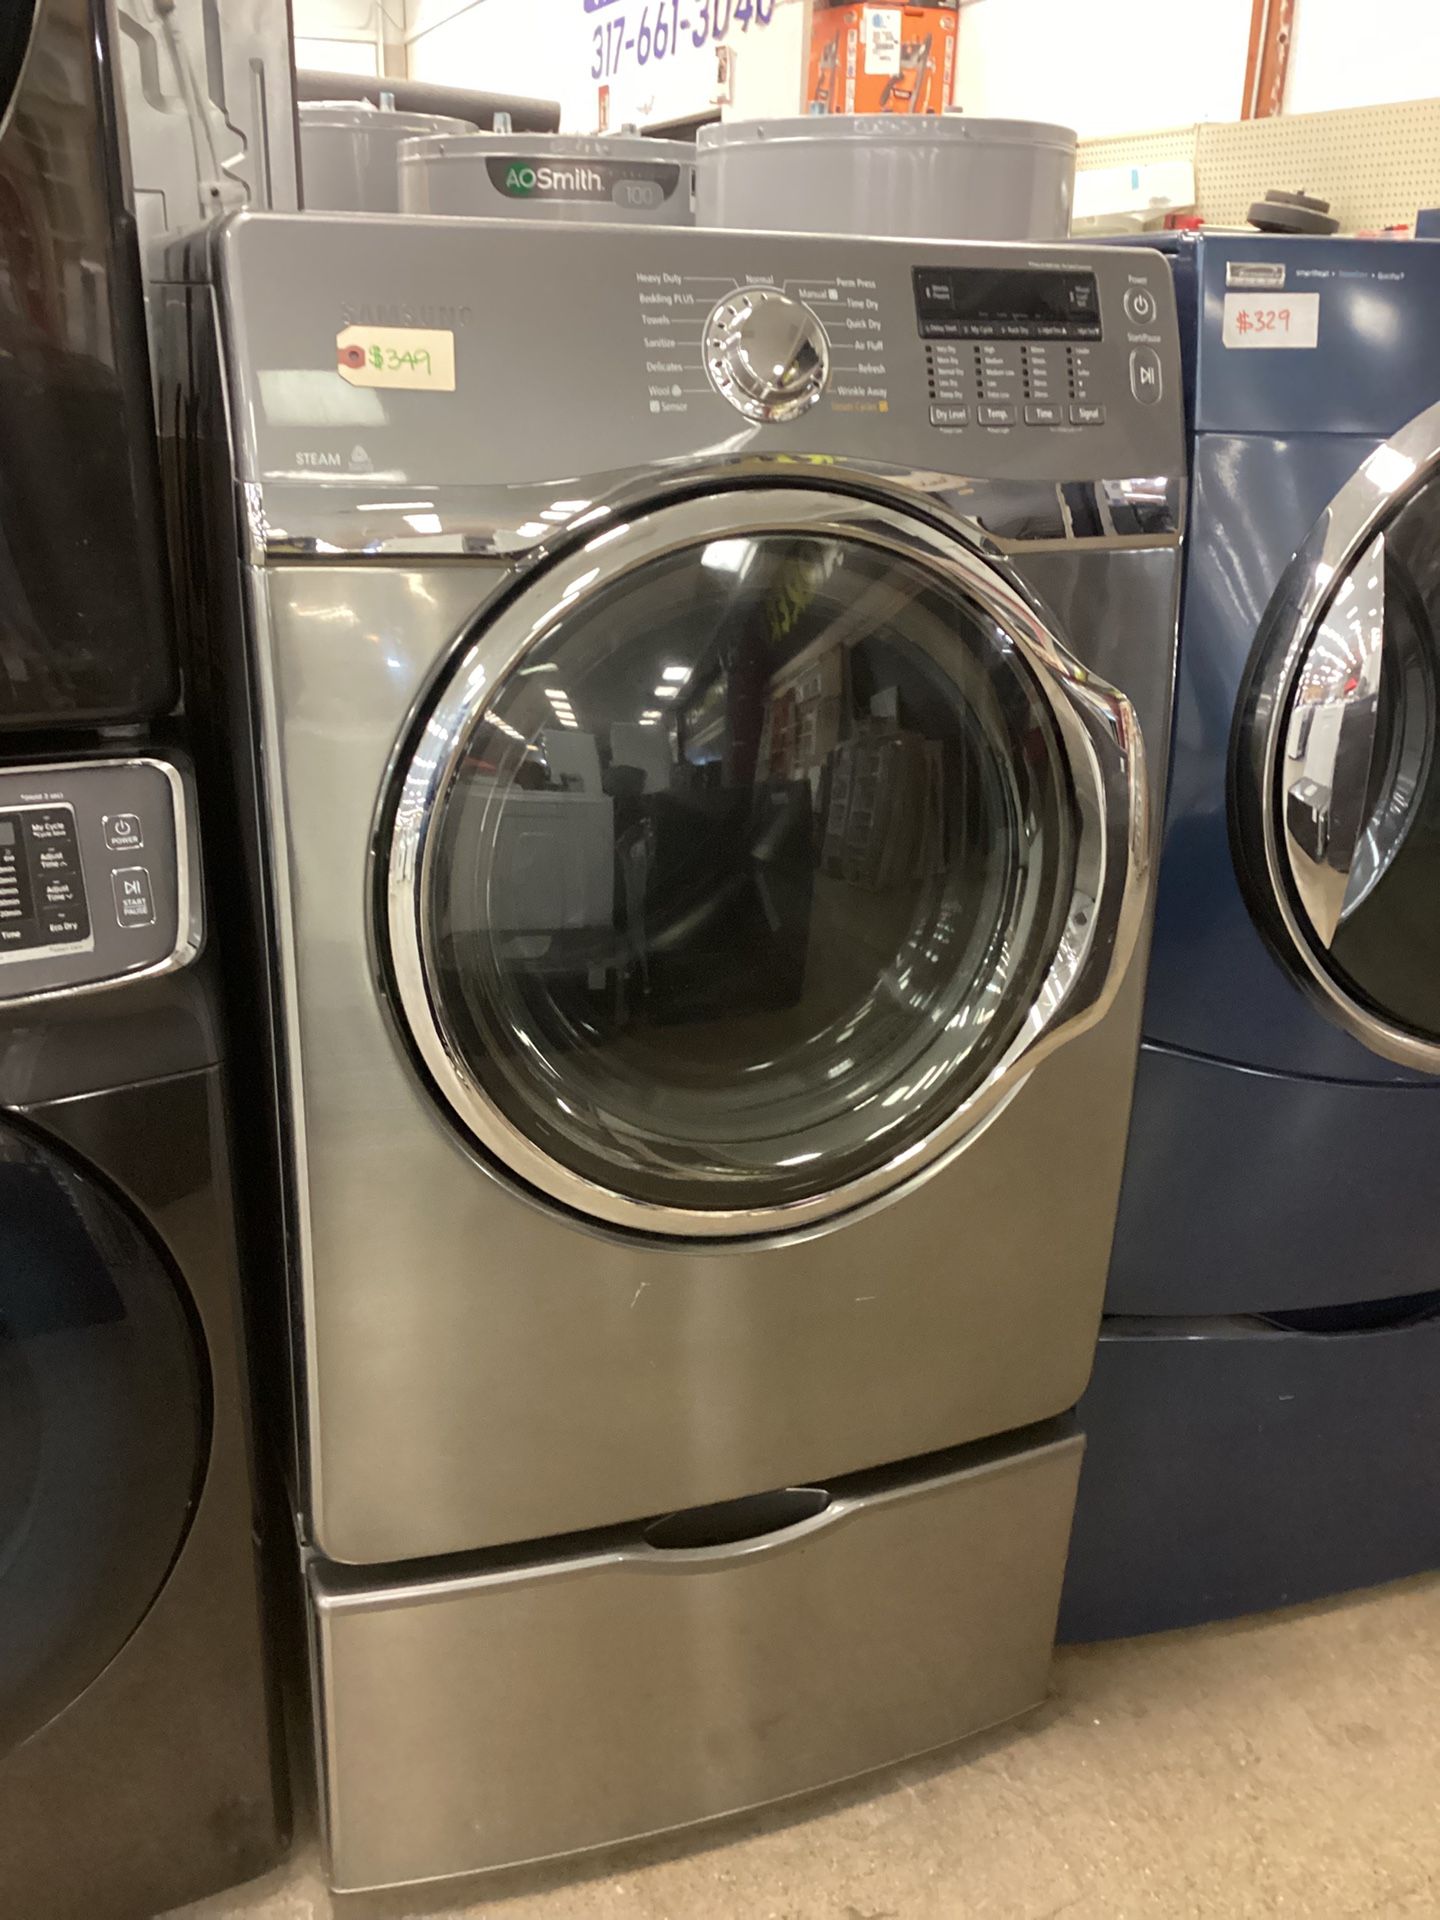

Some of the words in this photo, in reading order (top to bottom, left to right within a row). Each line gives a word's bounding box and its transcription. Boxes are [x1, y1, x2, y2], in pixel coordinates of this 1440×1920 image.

[625, 184, 653, 200] 100
[637, 273, 661, 285] Heavy
[663, 273, 682, 285] Duty
[746, 275, 774, 285] Normal
[836, 278, 855, 288] Perm
[857, 279, 876, 289] Press
[1128, 275, 1148, 285] Power
[799, 289, 827, 299] Manual
[640, 294, 672, 305] Bedding
[674, 294, 694, 304] PLUS
[847, 299, 865, 309] Time
[866, 300, 879, 311] Dry
[642, 315, 670, 325] Towels
[846, 319, 865, 330] Quick
[867, 320, 881, 331] Dry
[1236, 309, 1291, 334] $329
[1127, 332, 1161, 343] Start/Pause
[644, 338, 675, 348] Sanitize
[855, 341, 865, 350] Air
[866, 341, 883, 351] Fluff
[369, 345, 432, 376] $349
[647, 362, 683, 372] Delicates
[858, 364, 885, 374] Refresh
[649, 386, 670, 396] Wool
[838, 386, 864, 396] Wrinkle
[866, 387, 887, 398] Away
[662, 402, 687, 412] Sensor
[936, 408, 948, 421] Dry
[949, 408, 966, 420] Level
[1036, 409, 1053, 419] Time
[1079, 407, 1099, 420] Signal
[296, 452, 341, 466] STEAM
[31, 823, 43, 833] My
[44, 822, 65, 834] Cycle
[111, 836, 139, 845] POWER
[40, 852, 63, 862] Adjust
[41, 861, 60, 869] Time
[46, 884, 69, 895] Adjust
[46, 893, 65, 902] Time
[123, 898, 146, 907] START
[50, 922, 64, 932] Eco
[63, 921, 78, 932] Dry
[1, 930, 21, 940] Time
